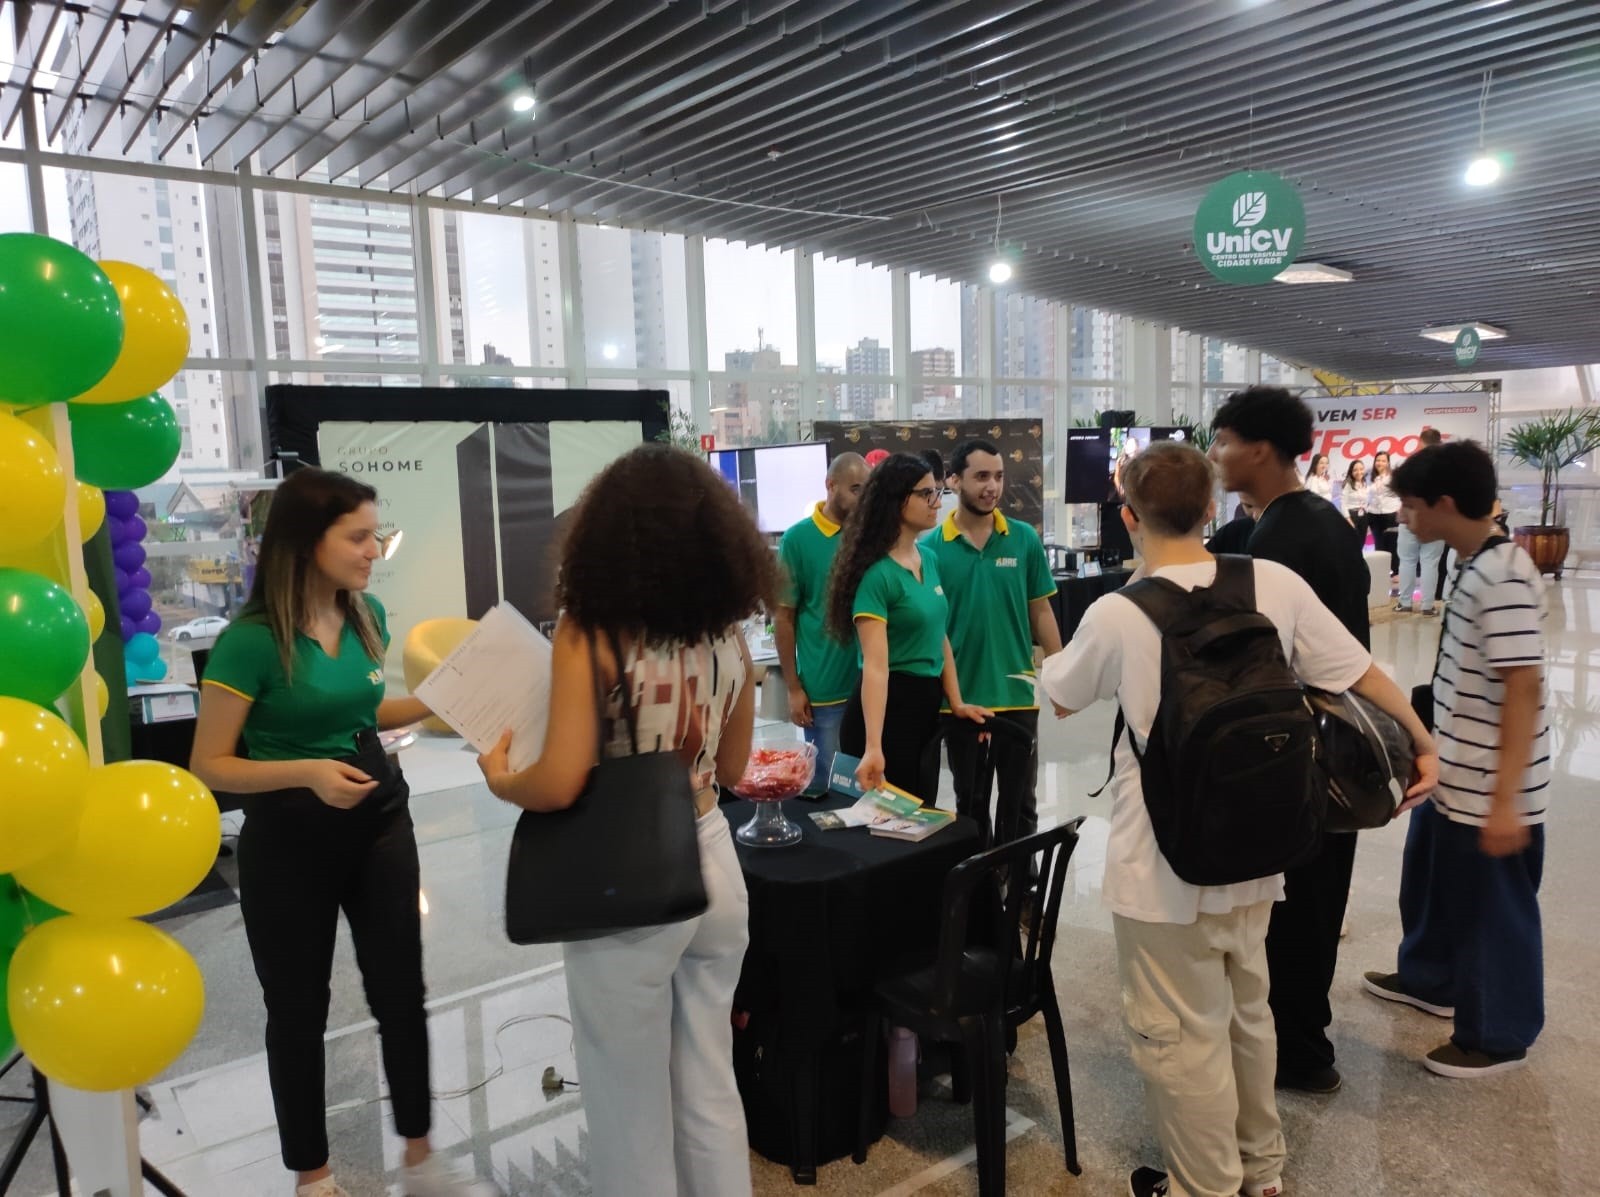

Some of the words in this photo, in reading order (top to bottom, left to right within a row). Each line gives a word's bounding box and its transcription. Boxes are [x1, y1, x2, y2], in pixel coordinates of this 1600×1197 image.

[1206, 228, 1293, 254] UniCV
[1211, 253, 1238, 261] CENTRO
[1217, 258, 1250, 267] CIDADE
[1252, 257, 1282, 265] VERDE
[1318, 409, 1357, 422] VEM
[1362, 407, 1397, 421] SER
[339, 460, 424, 473] SOHOME
